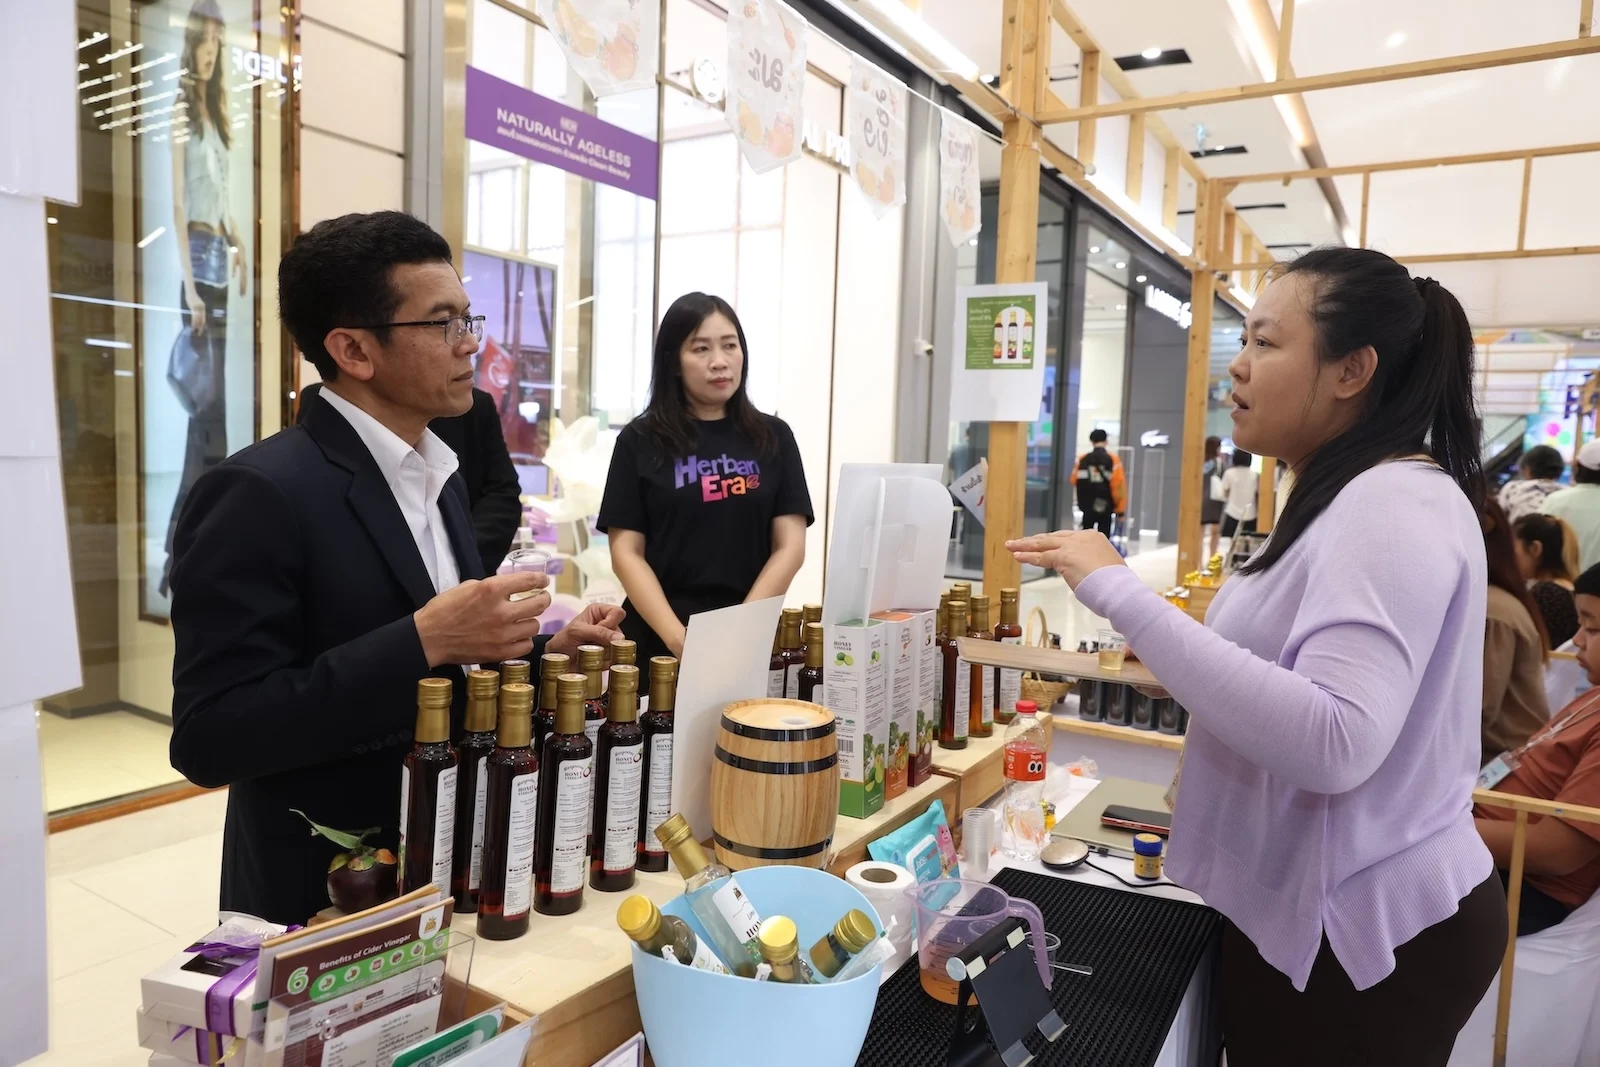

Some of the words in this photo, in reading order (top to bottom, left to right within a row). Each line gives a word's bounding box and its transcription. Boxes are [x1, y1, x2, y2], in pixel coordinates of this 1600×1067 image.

[496, 106, 575, 147] NATURALLY
[577, 138, 632, 169] AGELESS
[674, 453, 760, 490] Herban
[701, 474, 747, 503] Era
[286, 966, 309, 995] 6
[319, 955, 352, 971] Benefits
[353, 949, 362, 959] of
[363, 944, 383, 956] Cider
[384, 933, 412, 949] Vinegar
